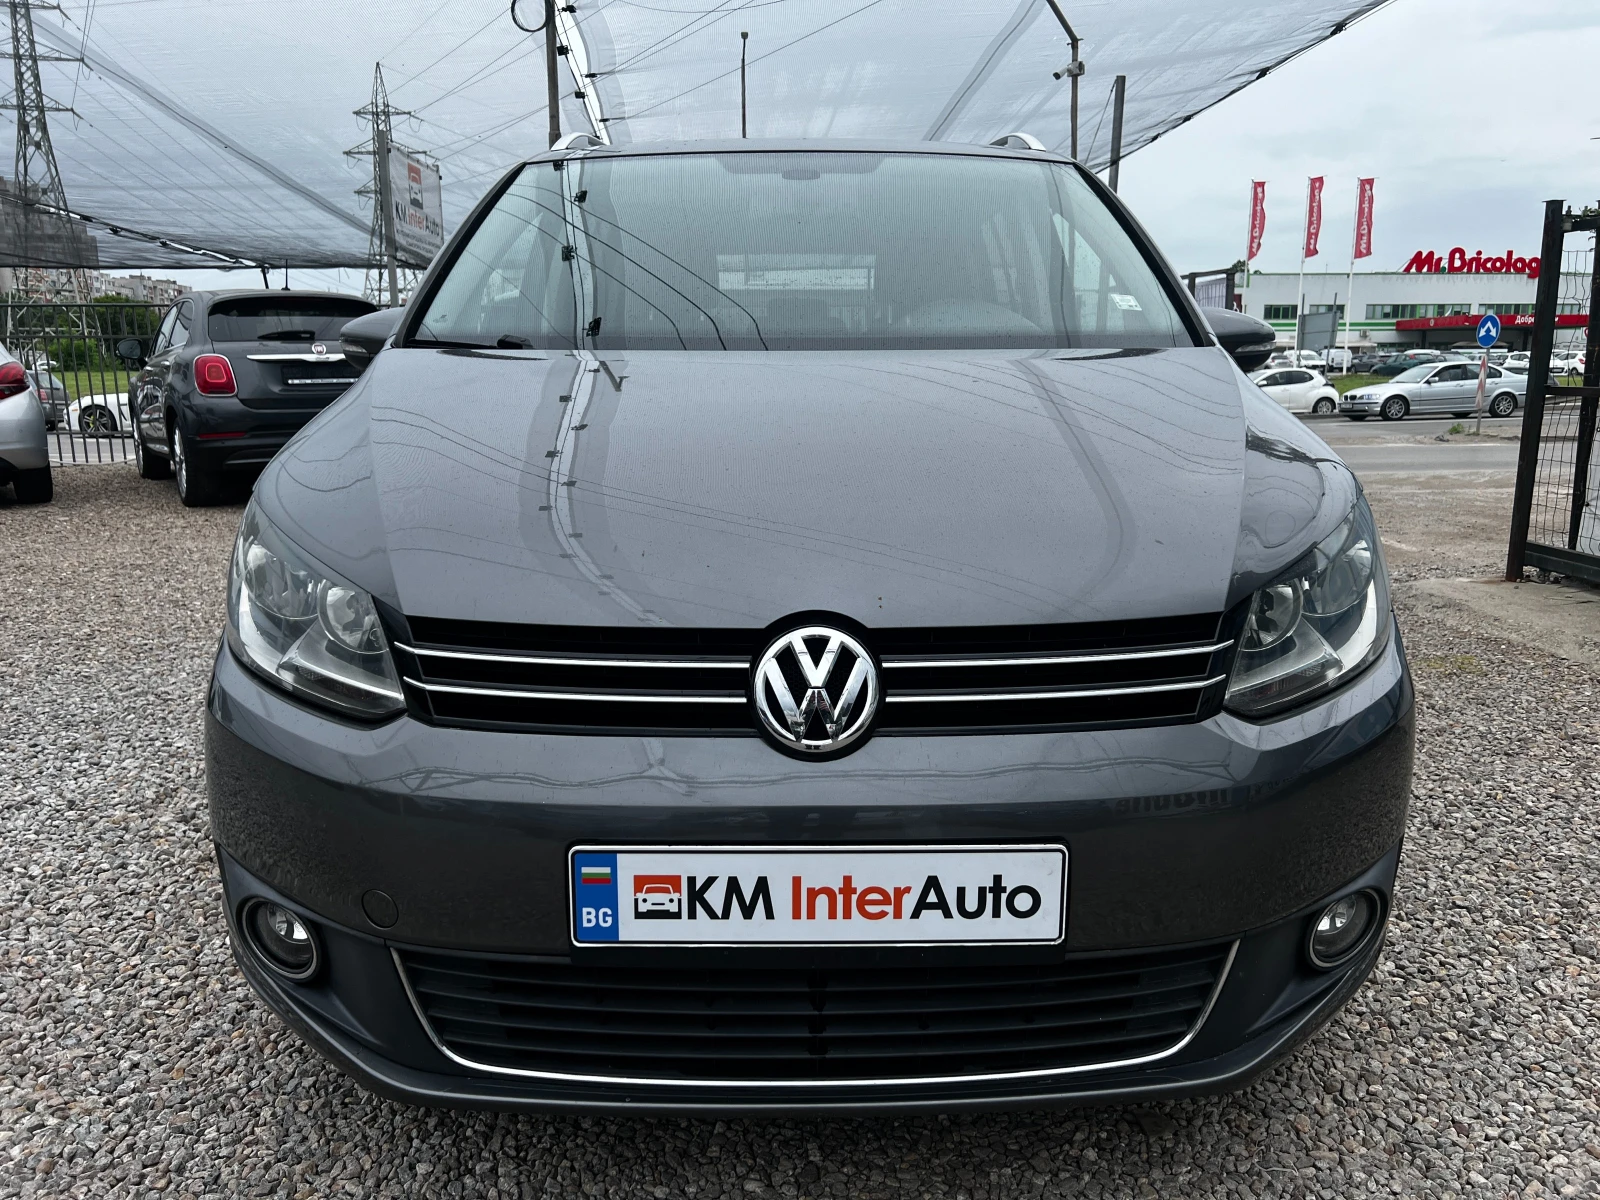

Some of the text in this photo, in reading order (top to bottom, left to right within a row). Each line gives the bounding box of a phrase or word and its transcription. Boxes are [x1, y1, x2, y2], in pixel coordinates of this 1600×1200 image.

[687, 874, 1042, 920] KM InterAuto
[582, 907, 613, 928] BG
